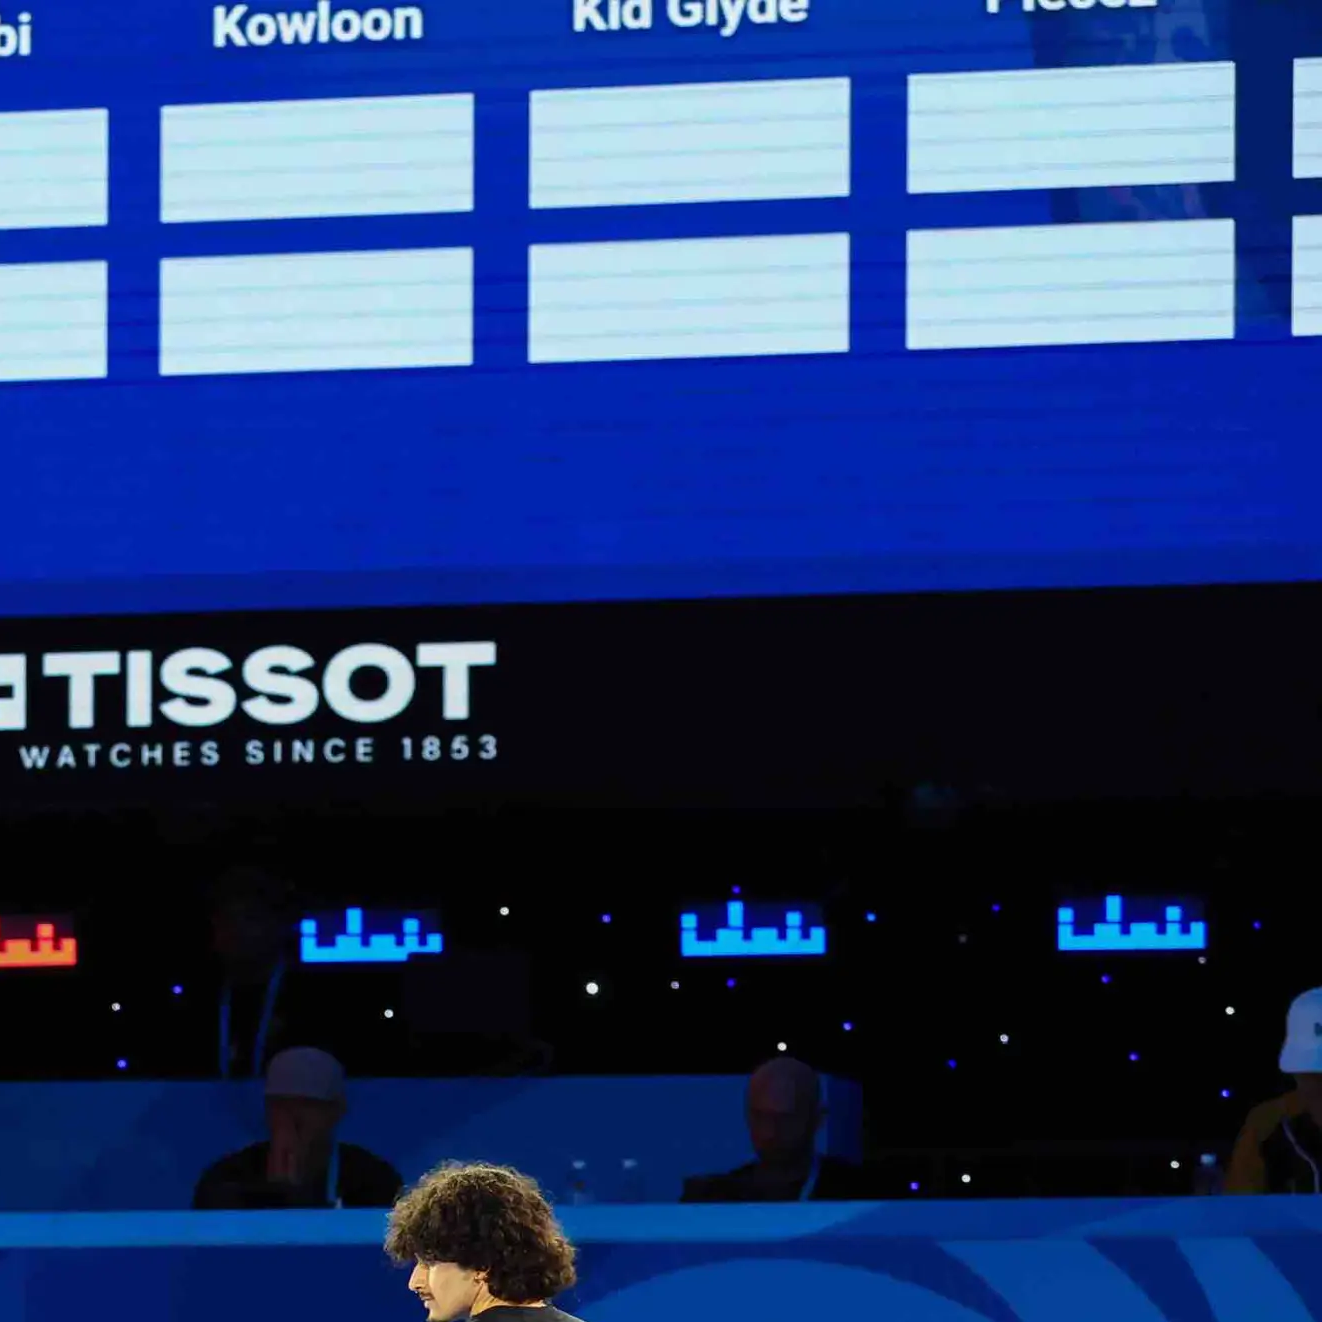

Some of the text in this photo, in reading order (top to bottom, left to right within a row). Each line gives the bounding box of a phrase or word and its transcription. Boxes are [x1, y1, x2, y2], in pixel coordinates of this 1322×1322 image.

[215, 0, 421, 46] Kowloon
[43, 642, 496, 728] TISSOT
[20, 741, 219, 768] WATCHES
[246, 738, 371, 764] SINCE
[403, 735, 496, 760] 1853
